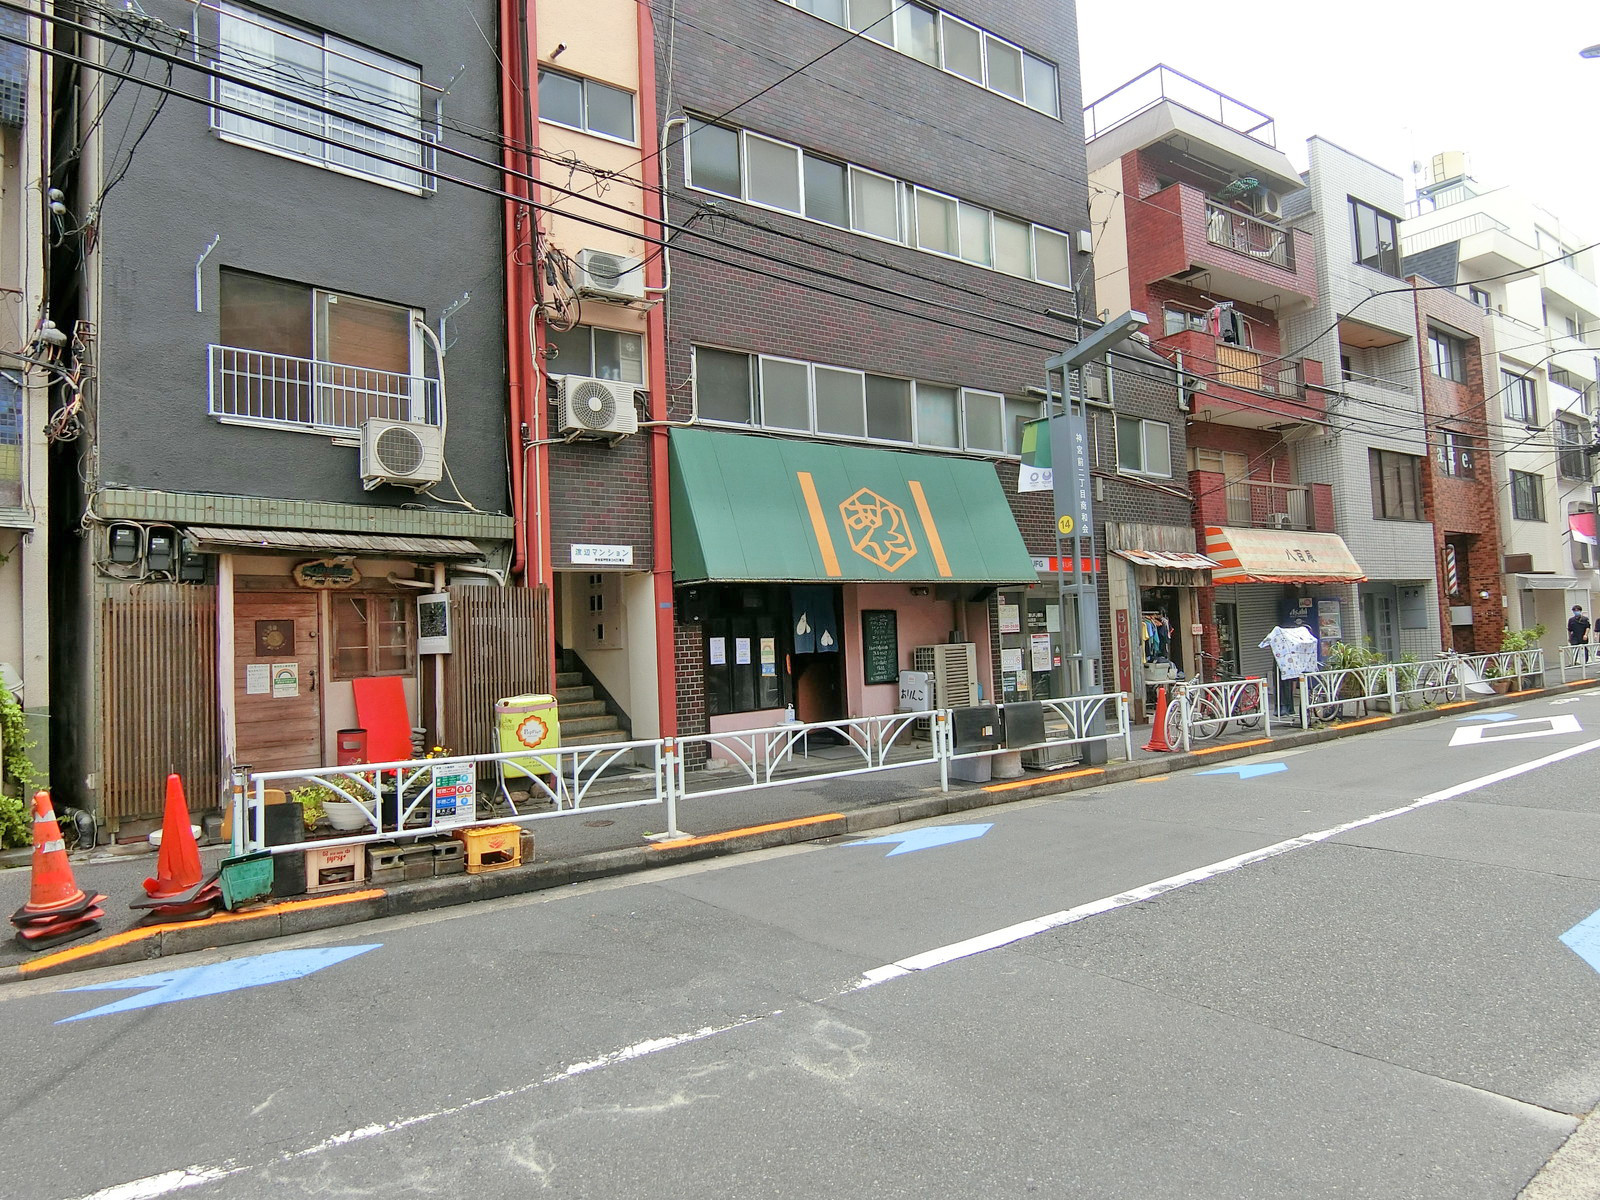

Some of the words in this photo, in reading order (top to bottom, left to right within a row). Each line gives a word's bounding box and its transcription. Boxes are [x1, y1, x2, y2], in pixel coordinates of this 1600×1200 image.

[1075, 433, 1089, 534] 神宮前二丁目商和会
[1060, 519, 1071, 530] 14
[575, 548, 629, 557] 渡辺マンション
[1156, 568, 1194, 585] BUDDY
[1118, 613, 1129, 678] BUDDY
